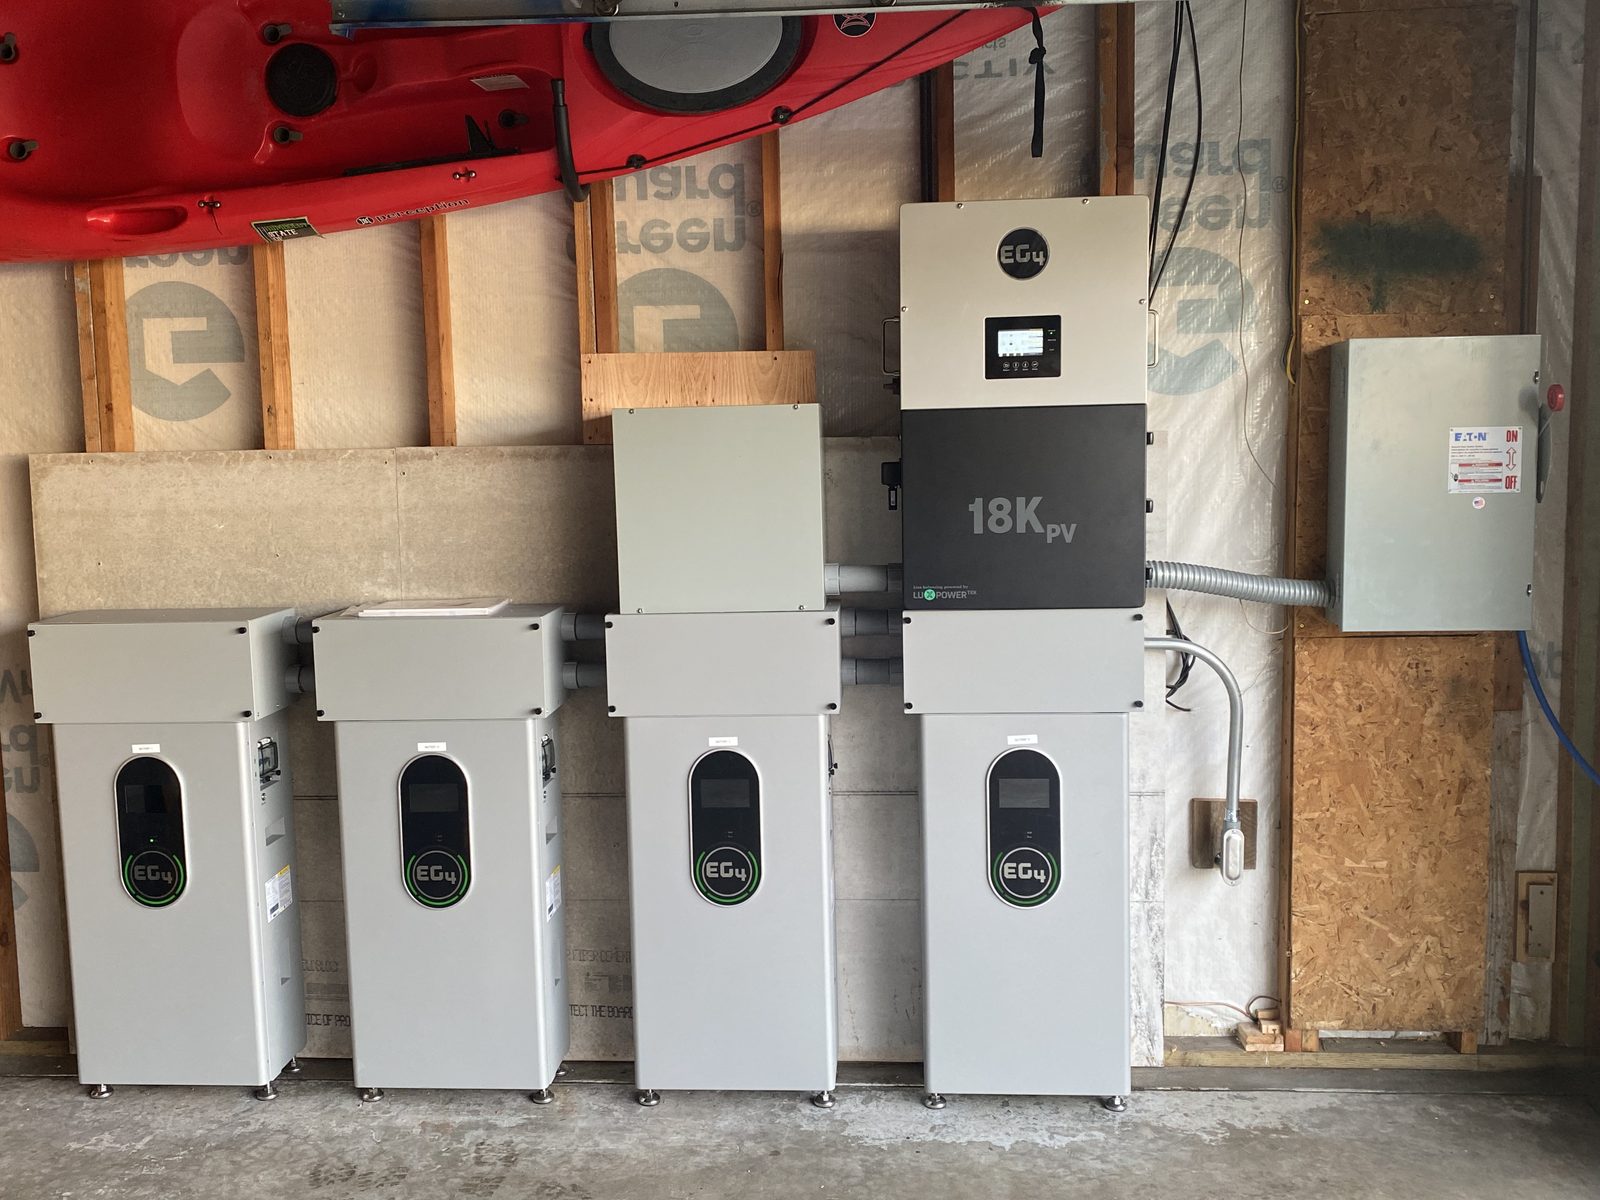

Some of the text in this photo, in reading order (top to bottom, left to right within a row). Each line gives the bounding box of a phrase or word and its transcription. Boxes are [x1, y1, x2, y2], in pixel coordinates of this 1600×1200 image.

[375, 199, 470, 222] perception
[1000, 244, 1046, 266] EG4
[1506, 430, 1518, 442] ON
[1505, 476, 1518, 489] OFF
[133, 864, 173, 884] EG4
[416, 865, 457, 885] EG4
[706, 861, 747, 882] EG4
[1003, 862, 1046, 883] EG4
[590, 1004, 606, 1018] THE
